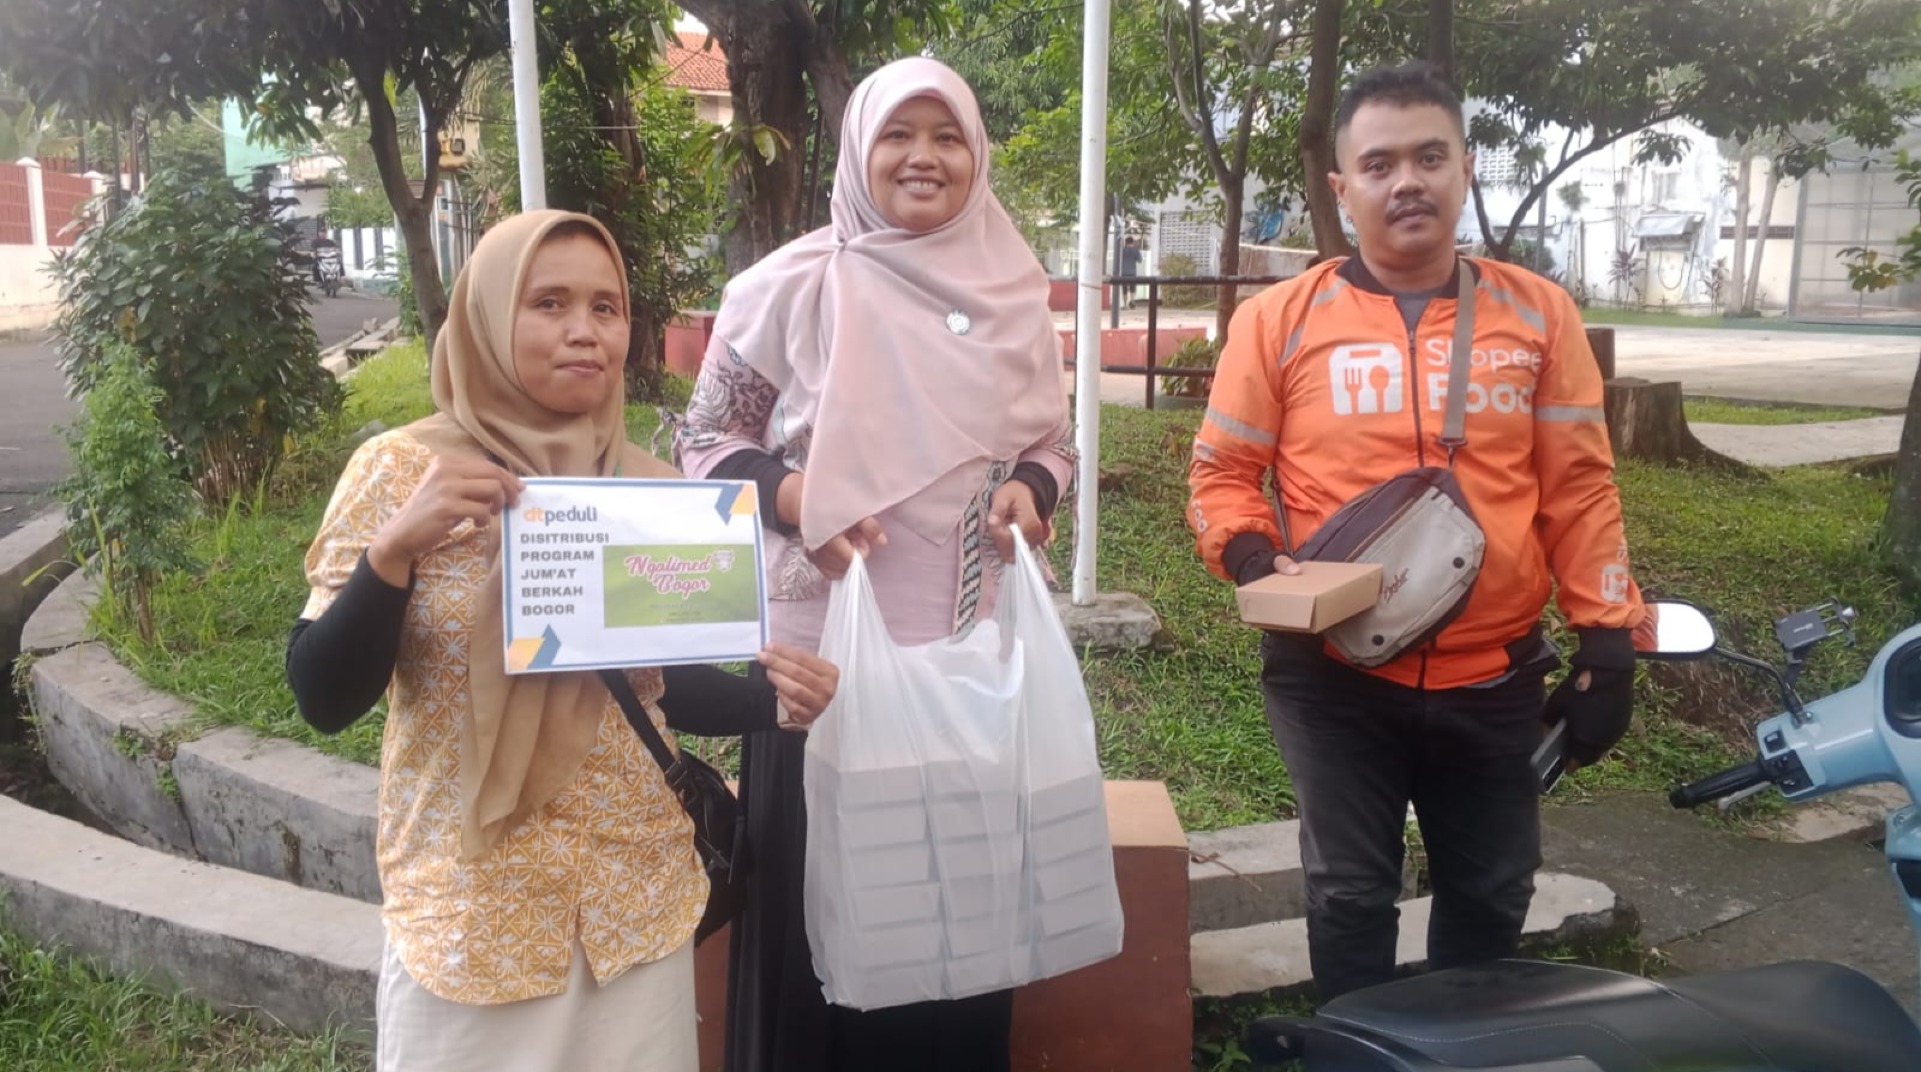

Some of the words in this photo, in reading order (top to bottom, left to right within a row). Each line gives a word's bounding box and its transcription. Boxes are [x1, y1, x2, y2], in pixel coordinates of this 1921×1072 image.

[520, 532, 610, 544] DISITRIBUSI
[520, 550, 595, 562] PROGRAM
[520, 568, 577, 580] JUM'AT
[521, 586, 584, 598] BERKAH
[653, 573, 710, 599] Bogor
[521, 604, 576, 616] BOGOR
